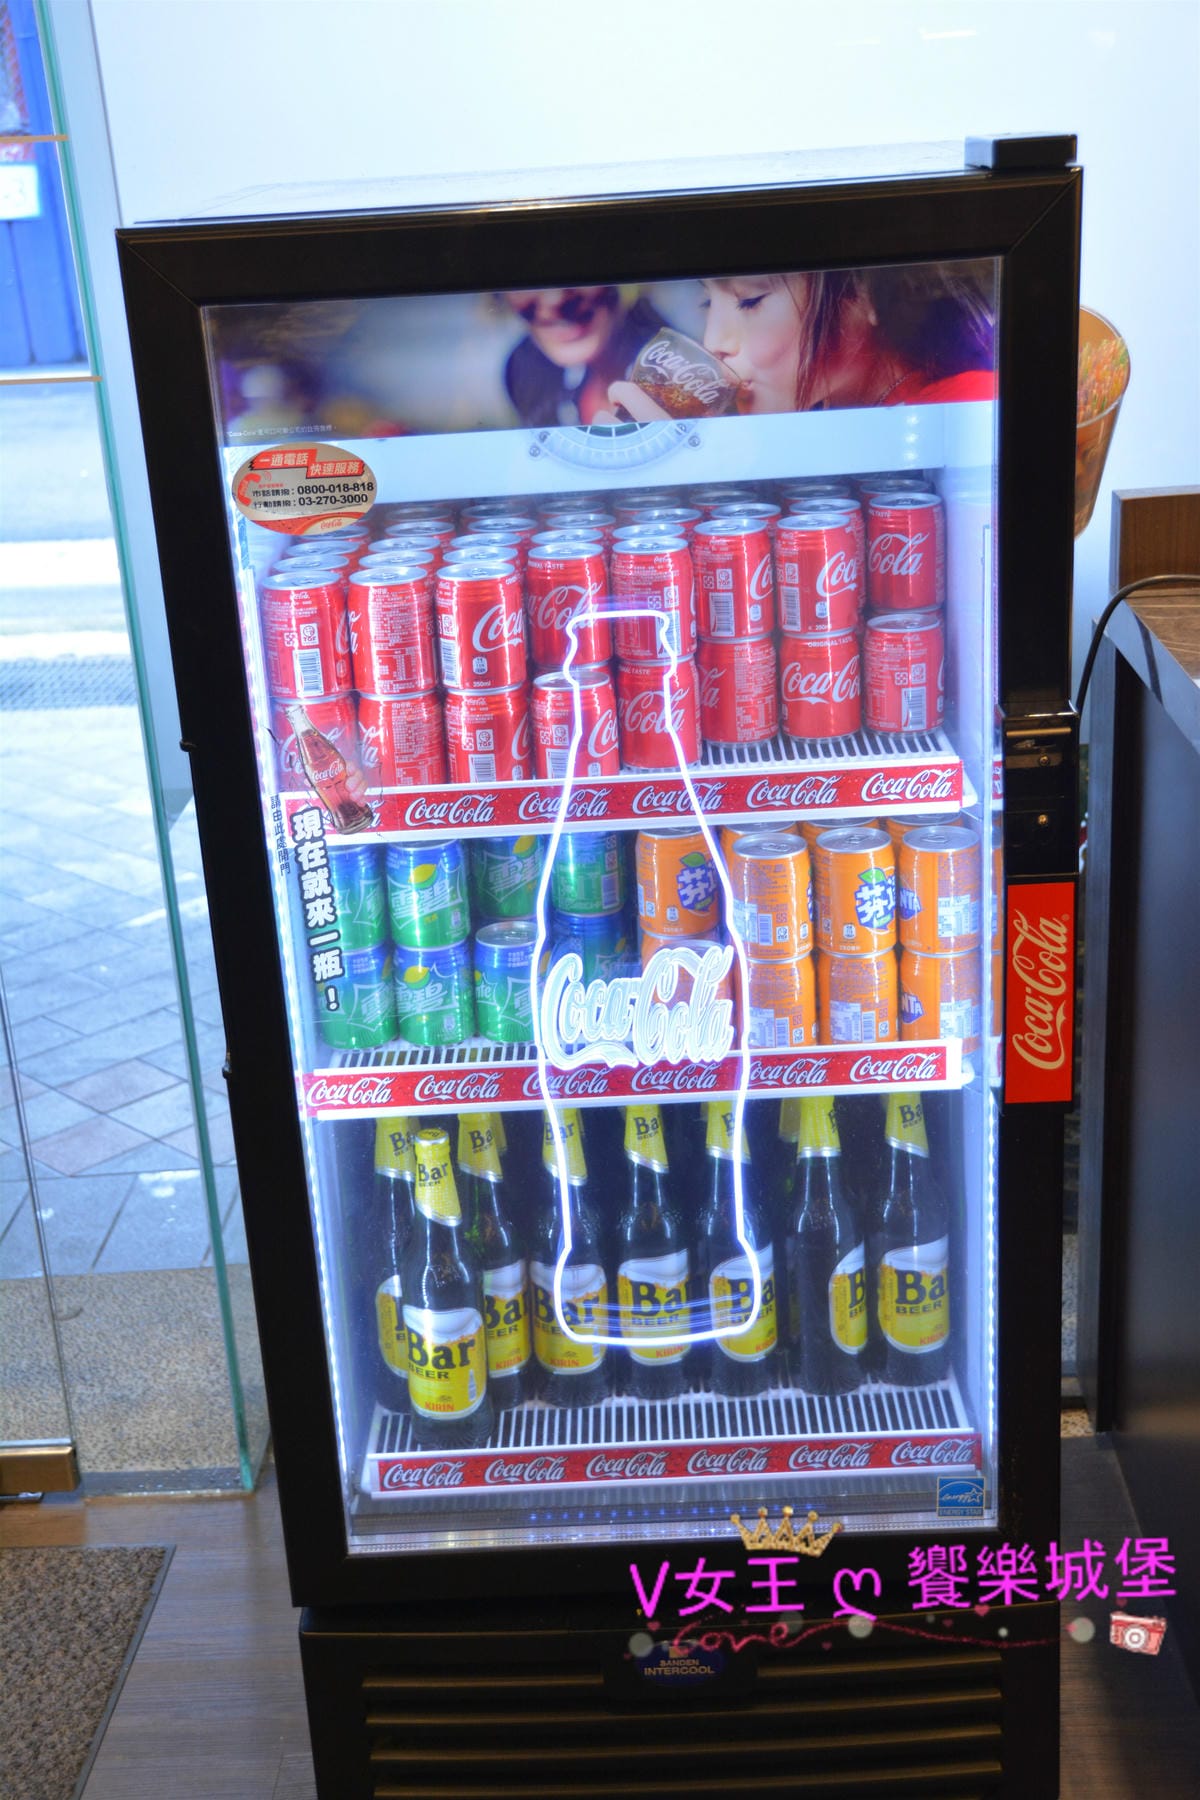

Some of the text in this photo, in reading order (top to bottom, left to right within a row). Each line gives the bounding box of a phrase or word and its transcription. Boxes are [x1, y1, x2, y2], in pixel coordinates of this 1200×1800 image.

[640, 340, 730, 404] Coca-Cola
[259, 453, 309, 467] 一通電話
[309, 462, 360, 476] 快速服務
[297, 481, 374, 496] 0800-018-818
[298, 494, 369, 506] 03-270-3000
[404, 793, 499, 827] Coca-Cola
[518, 787, 613, 821] Coca-Cola
[632, 782, 728, 815] Coca-Cola
[746, 774, 843, 809] Coca-Cola
[860, 768, 958, 801] Coca-Cola
[291, 807, 344, 1011] 現在就來一瓶！
[1012, 908, 1069, 1071] Coca-Cola
[541, 945, 734, 1070] Coca-Cola
[306, 1076, 399, 1107] Coca-Cola
[414, 1072, 504, 1102] Coca-Cola
[631, 1062, 722, 1092] Coca-Cola
[849, 1052, 943, 1083] Coca-Cola
[417, 1162, 449, 1182] Bar
[407, 1326, 476, 1370] Bar
[408, 1361, 450, 1379] BEER
[424, 1400, 455, 1412] KIRIN
[383, 1437, 978, 1489] Coca-Cola Coca-Cola Coca-Cola Coca-Cola Coca-Cola Coca-Cola
[643, 1665, 716, 1676] INTERCOOL
[659, 1659, 700, 1667] SANDEN
